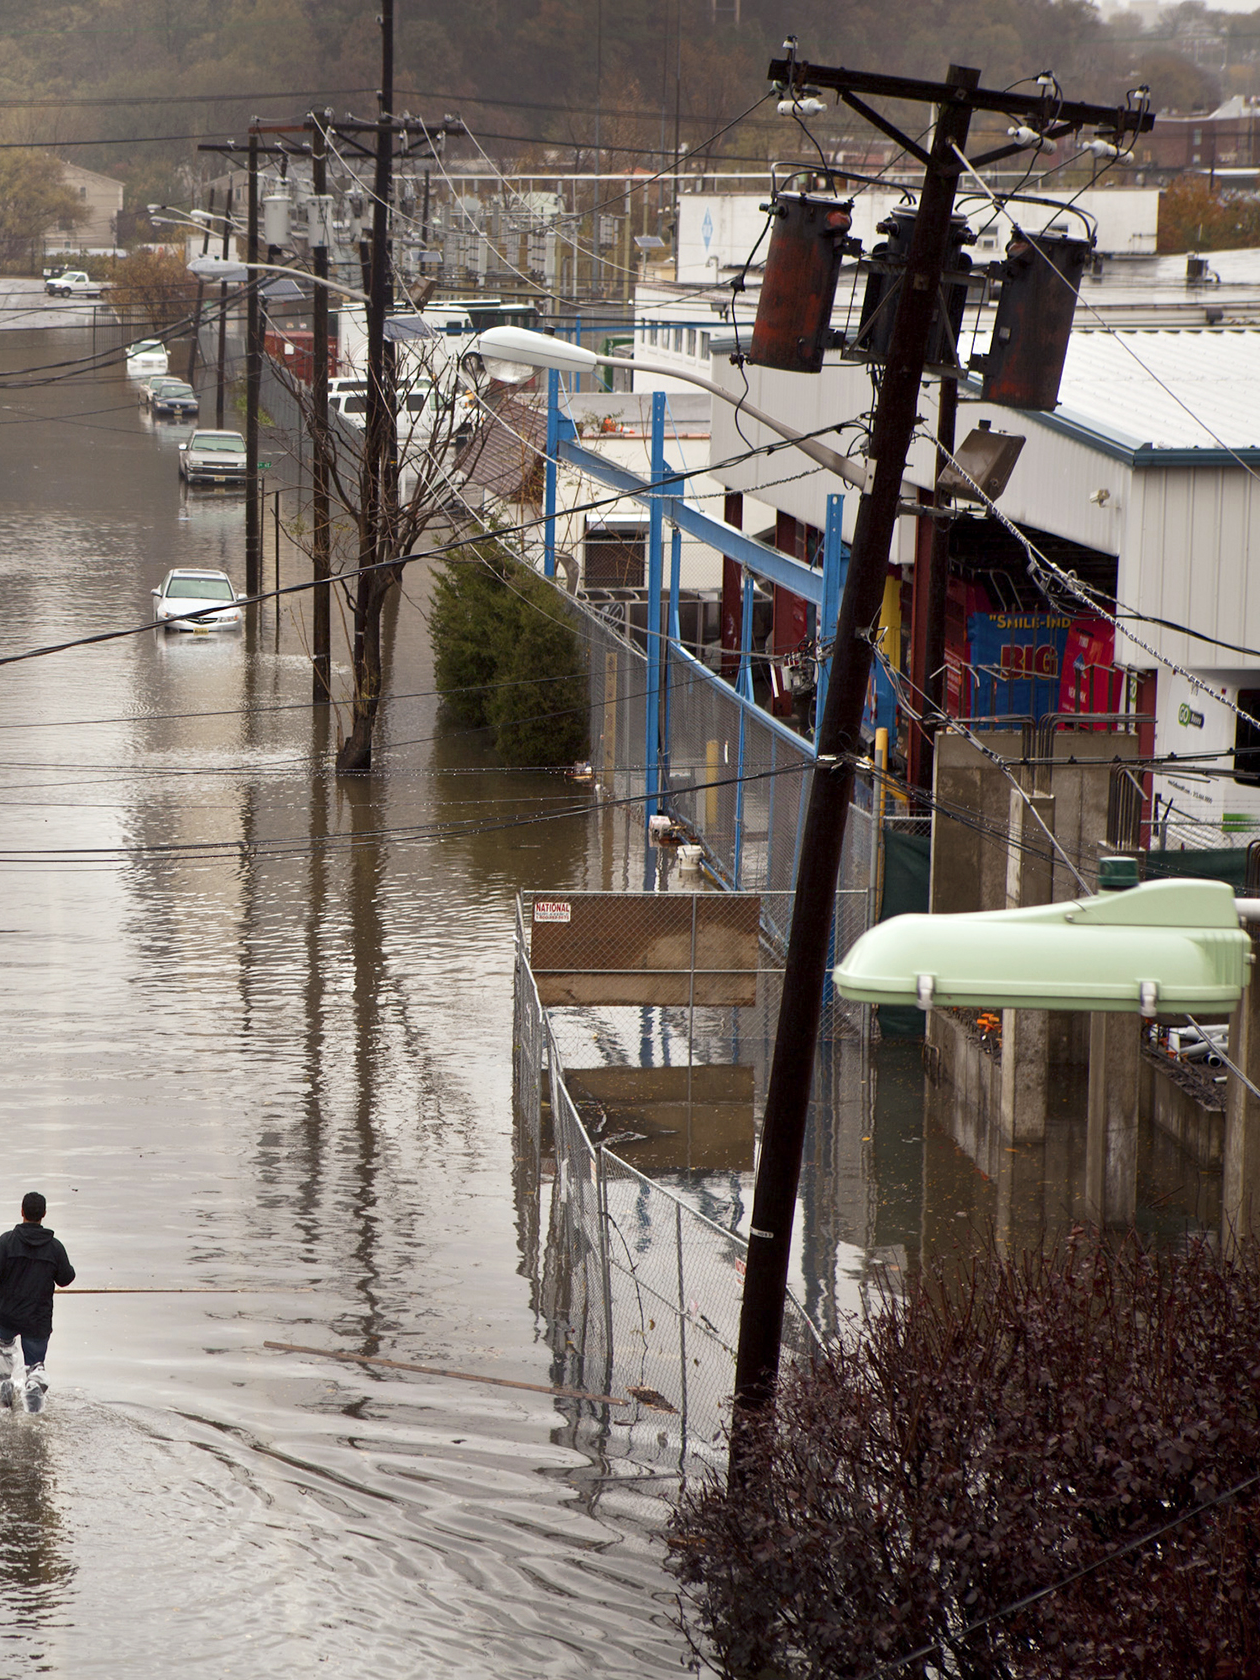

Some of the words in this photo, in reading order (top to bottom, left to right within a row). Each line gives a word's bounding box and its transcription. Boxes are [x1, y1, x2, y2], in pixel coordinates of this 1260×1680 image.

[990, 614, 1072, 629] "SMILE-IND
[1000, 644, 1058, 680] BIG
[1178, 706, 1189, 723] GO
[536, 904, 569, 912] NATIONAL
